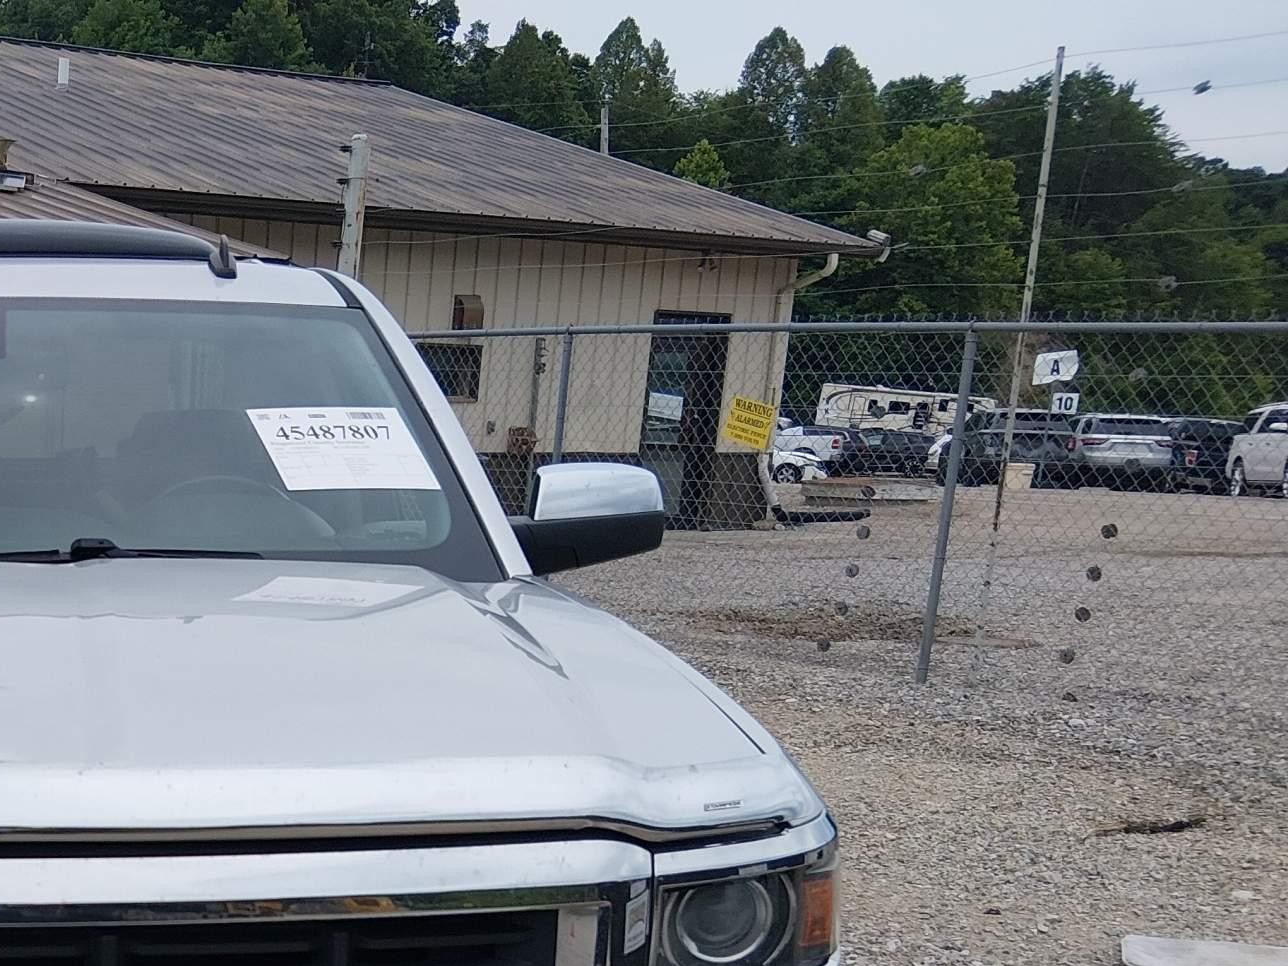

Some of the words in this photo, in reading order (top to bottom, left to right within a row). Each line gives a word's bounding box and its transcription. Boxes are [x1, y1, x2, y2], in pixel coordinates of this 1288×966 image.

[1050, 359, 1060, 376] A
[735, 398, 773, 418] WARNING
[1056, 396, 1074, 411] 10
[275, 424, 390, 441] 45487807
